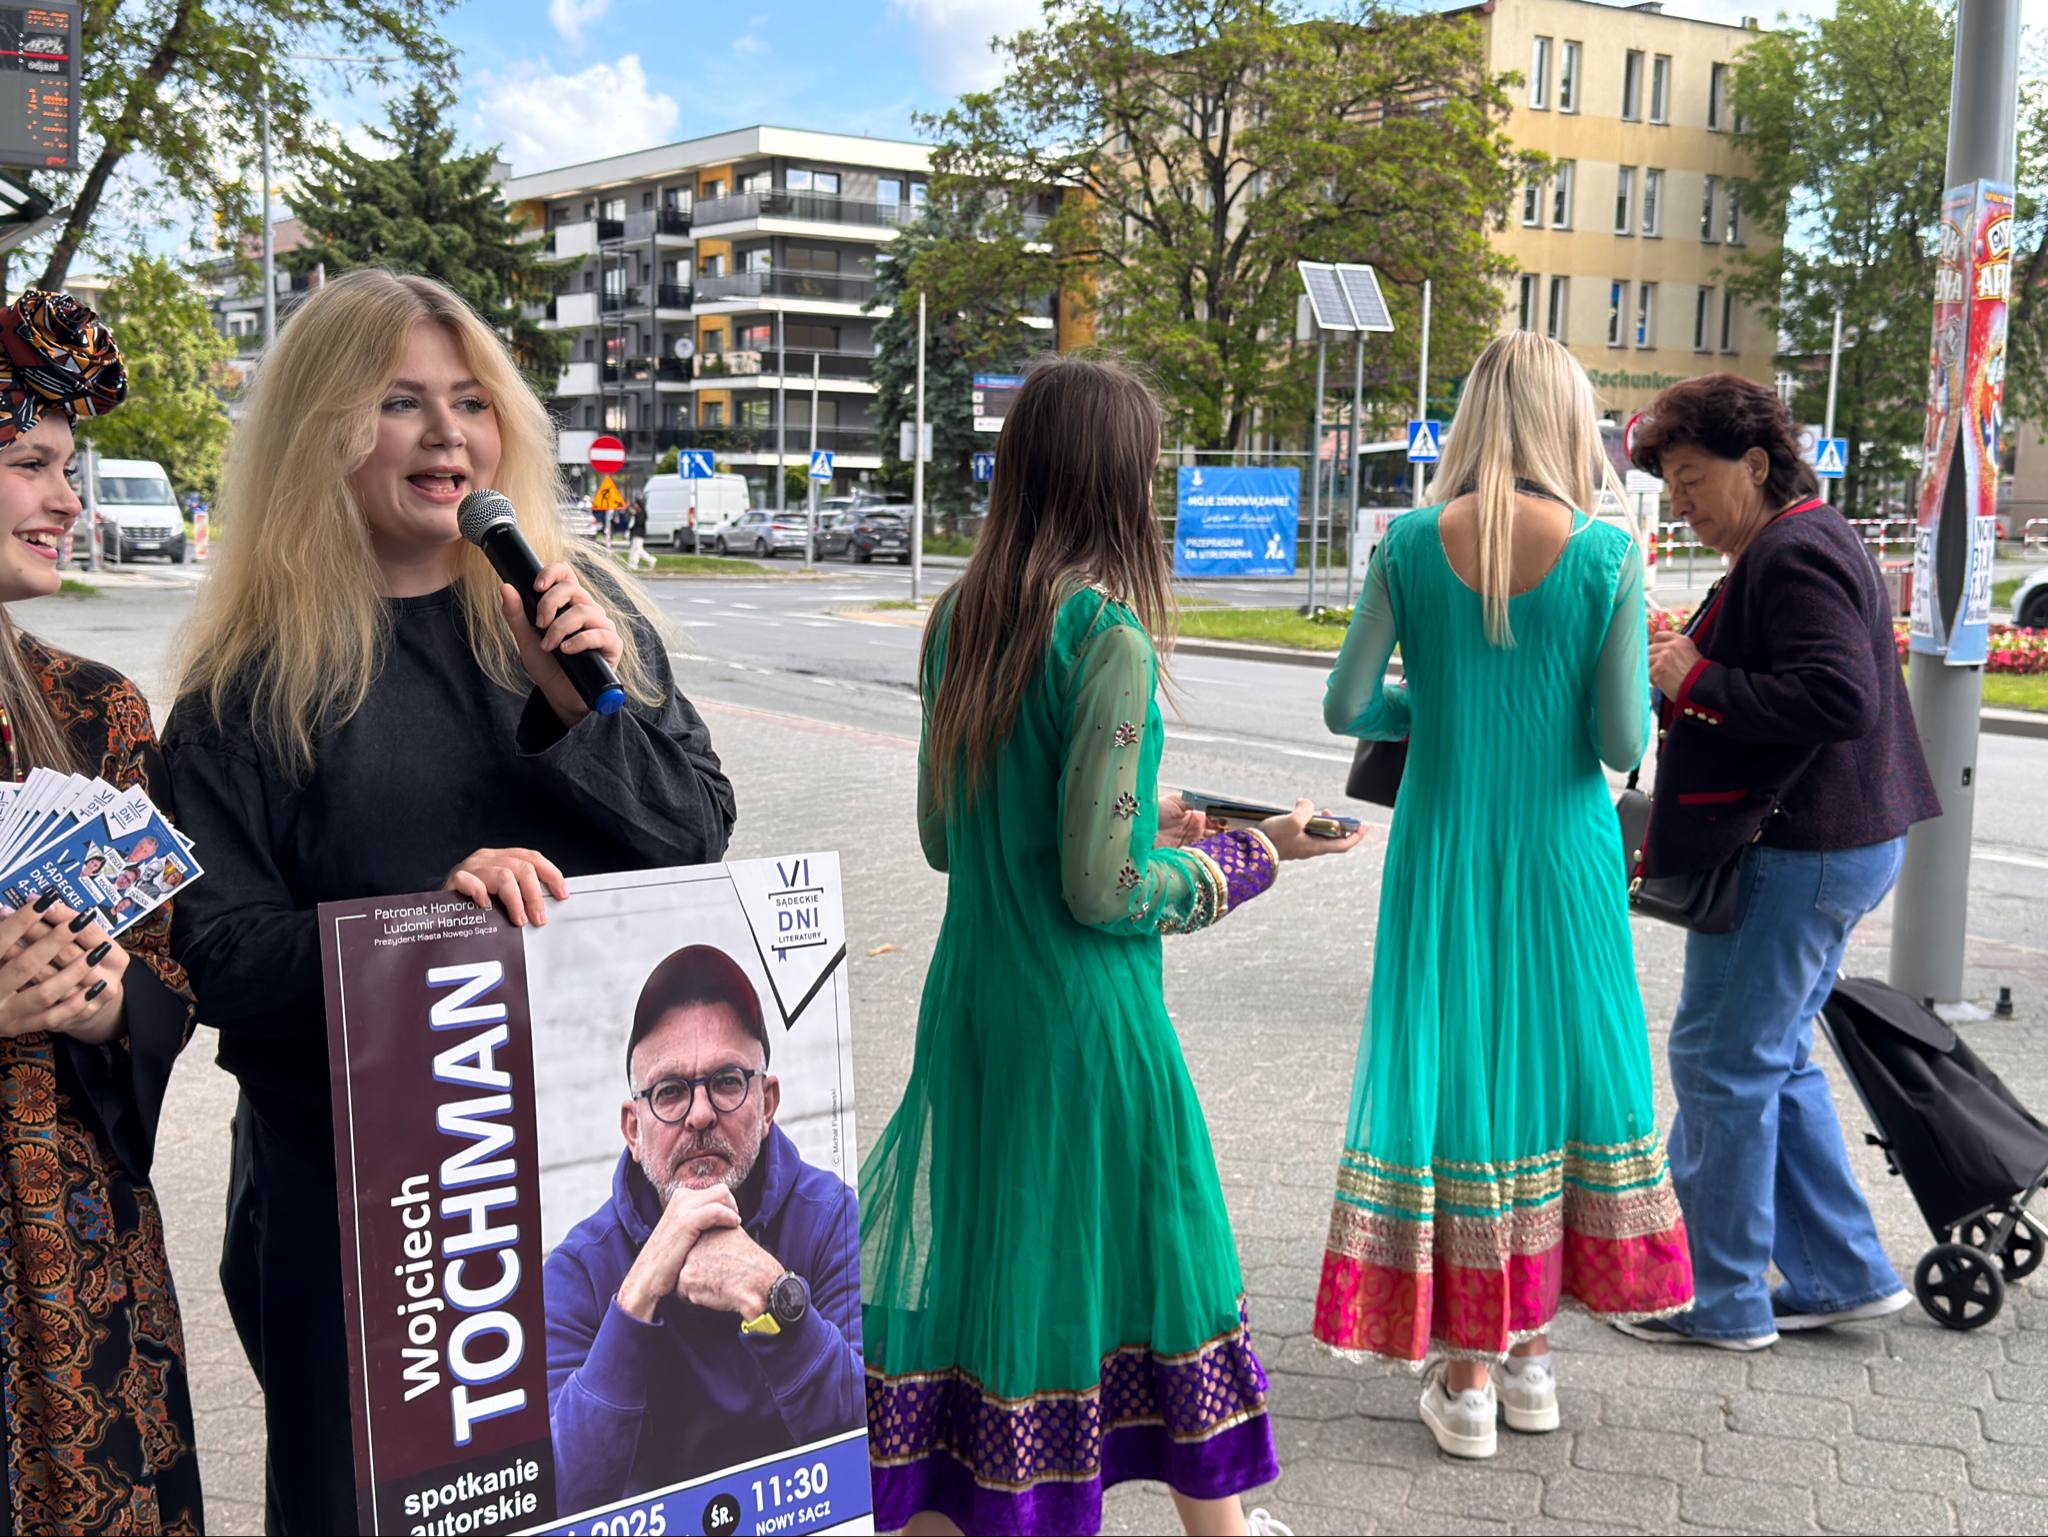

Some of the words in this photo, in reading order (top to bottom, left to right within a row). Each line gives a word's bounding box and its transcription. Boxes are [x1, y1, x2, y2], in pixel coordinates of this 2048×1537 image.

[43, 861, 84, 908] SĄDECKIE
[776, 858, 810, 888] VI
[374, 904, 428, 920] Patronat
[775, 894, 820, 908] SĄDECKIE
[383, 919, 435, 935] Ludomir
[437, 912, 488, 929] Handzel
[778, 907, 819, 932] DNI
[374, 936, 416, 947] Prezydent
[417, 933, 442, 941] Miasta
[442, 929, 474, 939] Nowego
[474, 925, 498, 936] Sącza
[778, 930, 822, 944] LITERATURY
[426, 960, 527, 1447] TOCHMAN
[391, 1174, 445, 1402] Wojciech
[404, 1458, 539, 1518] spotkanie
[752, 1462, 828, 1512] 11:30
[410, 1491, 537, 1536] autorskie
[711, 1504, 734, 1528] ŚR.
[756, 1512, 795, 1536] NOWY
[798, 1501, 831, 1522] SĄCZ
